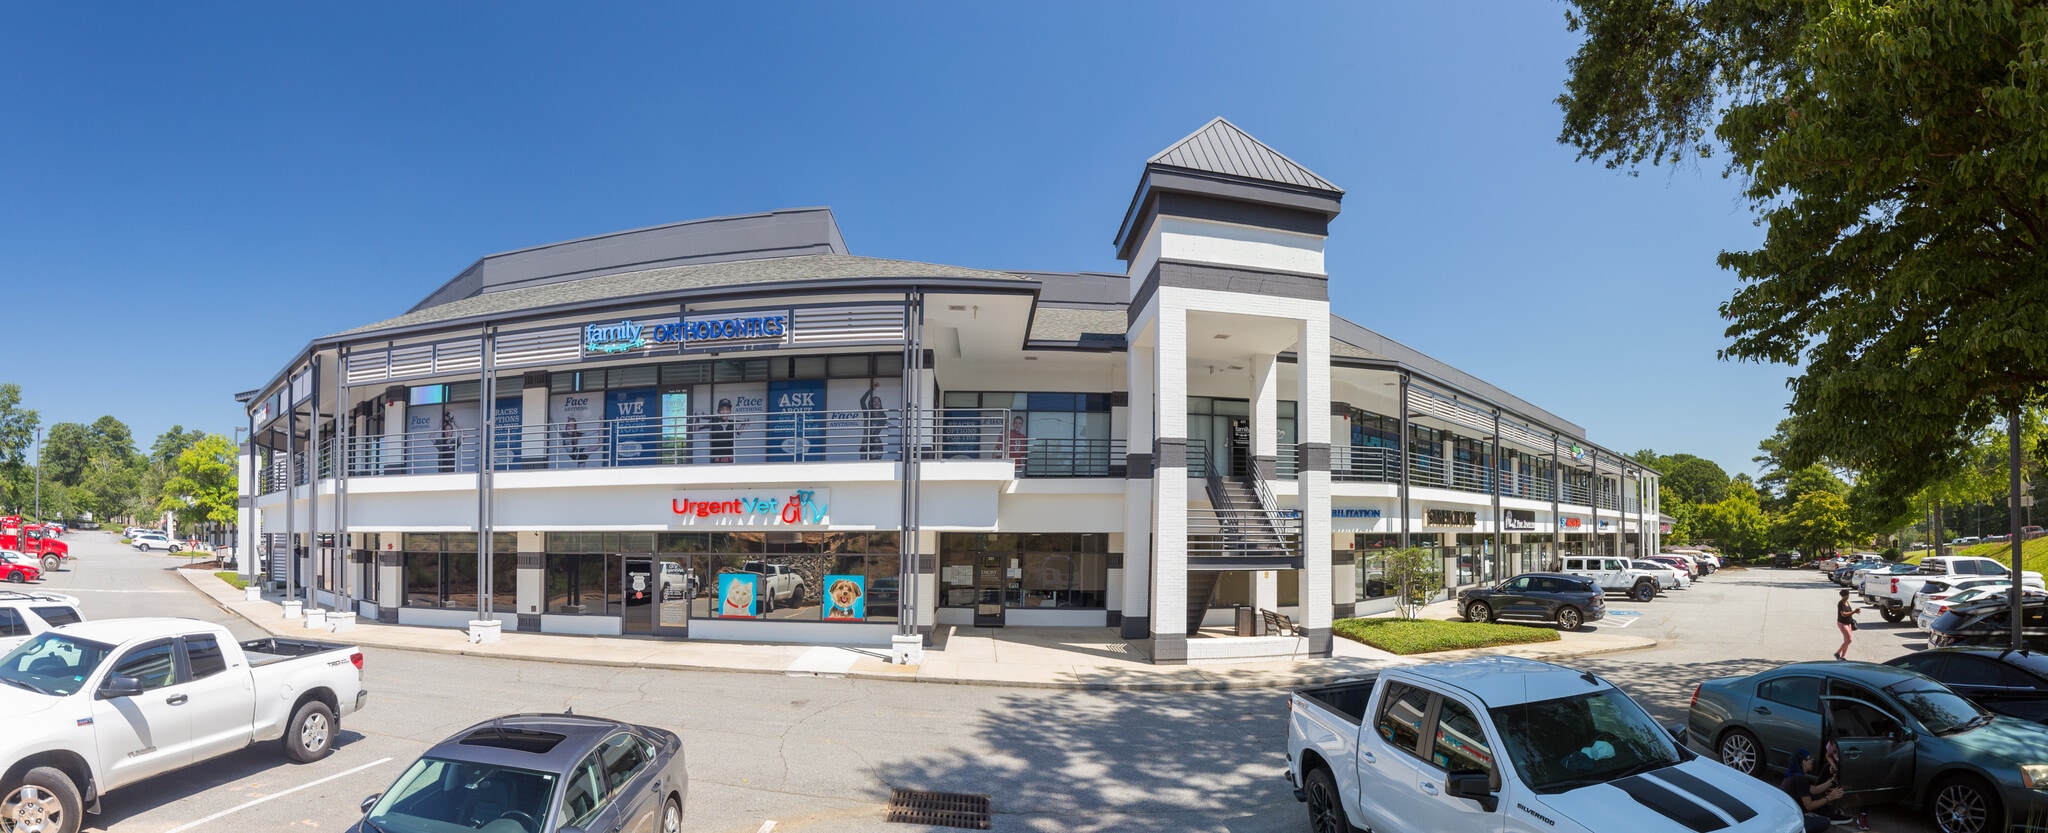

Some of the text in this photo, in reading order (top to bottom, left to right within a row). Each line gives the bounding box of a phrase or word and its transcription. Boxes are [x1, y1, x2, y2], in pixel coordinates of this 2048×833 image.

[587, 316, 786, 343] family ORTHODONTICS
[565, 397, 589, 407] Face
[736, 397, 763, 407] Face
[778, 393, 815, 407] ASK
[495, 408, 518, 416] RACES
[617, 402, 644, 415] WE
[411, 416, 431, 425] Face
[831, 412, 859, 420] Face
[1517, 802, 1556, 826] SILVERADO
